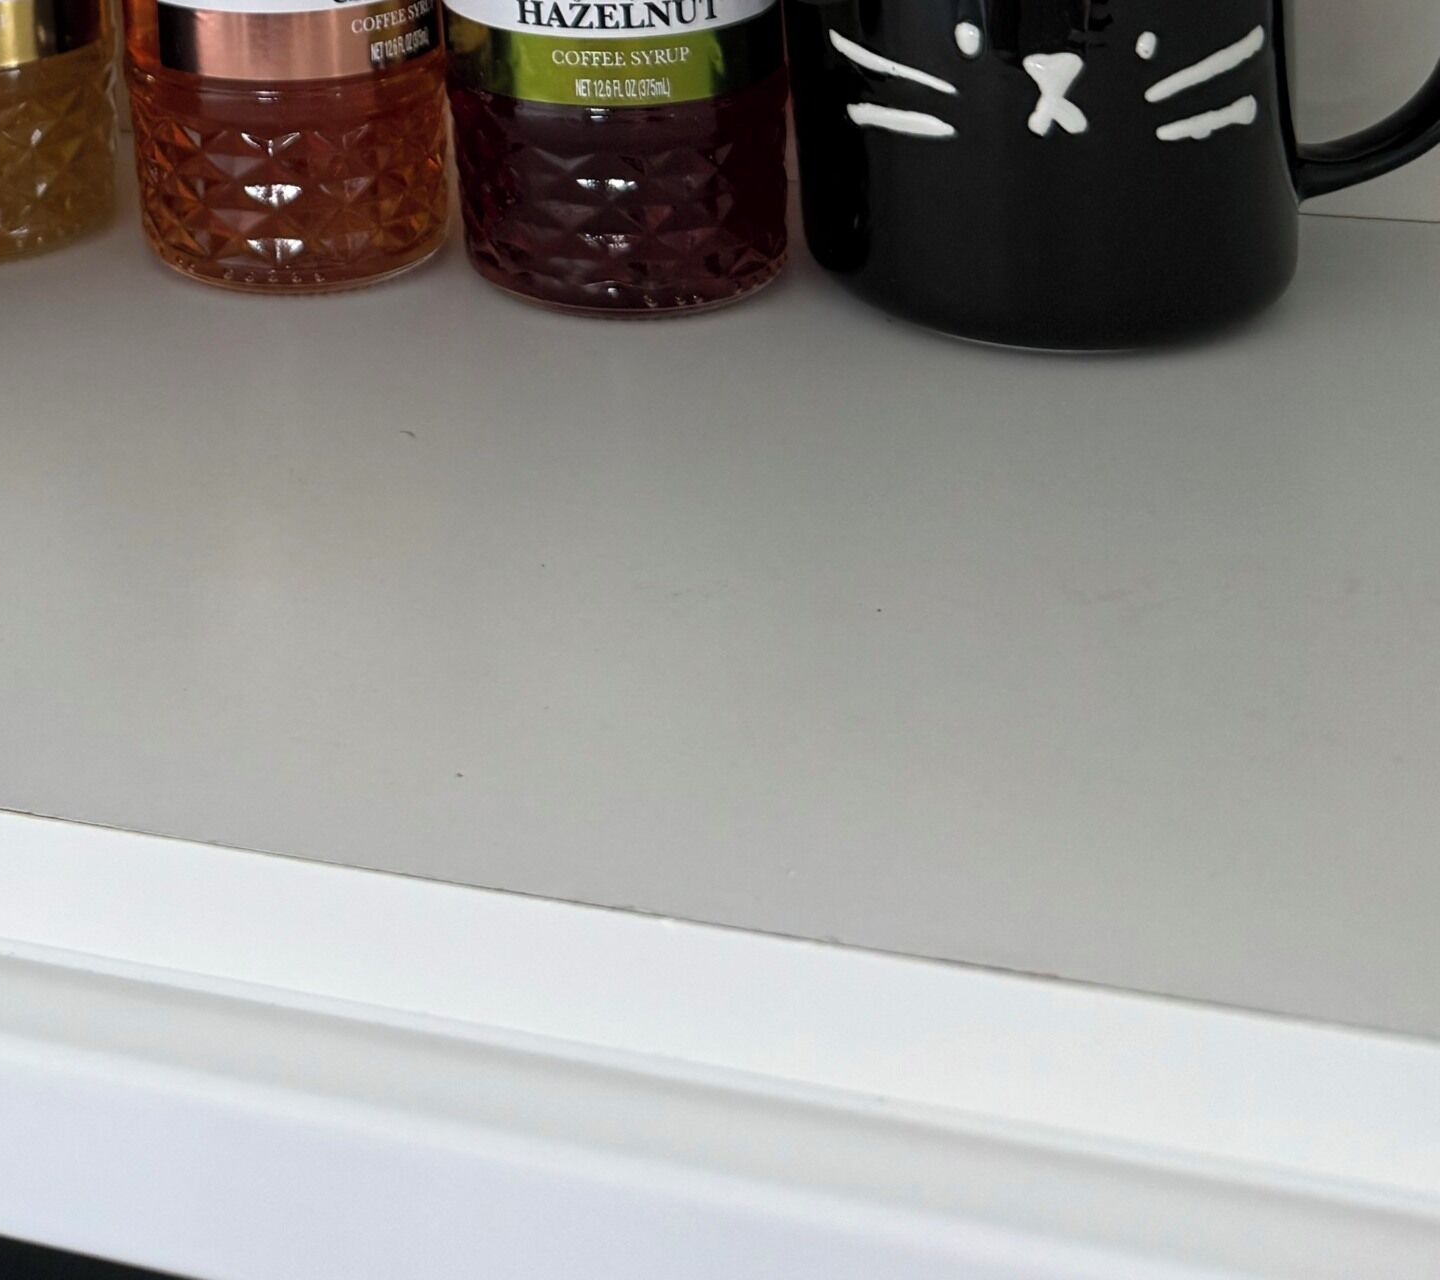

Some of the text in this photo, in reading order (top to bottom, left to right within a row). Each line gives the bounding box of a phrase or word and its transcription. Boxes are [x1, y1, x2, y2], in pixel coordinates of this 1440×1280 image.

[351, 8, 407, 34] COFFEE
[551, 46, 690, 67] COFFEE SYRUP
[575, 78, 592, 97] NET
[593, 78, 613, 97] 12.6
[613, 79, 624, 97] FL
[624, 79, 637, 97] OZ
